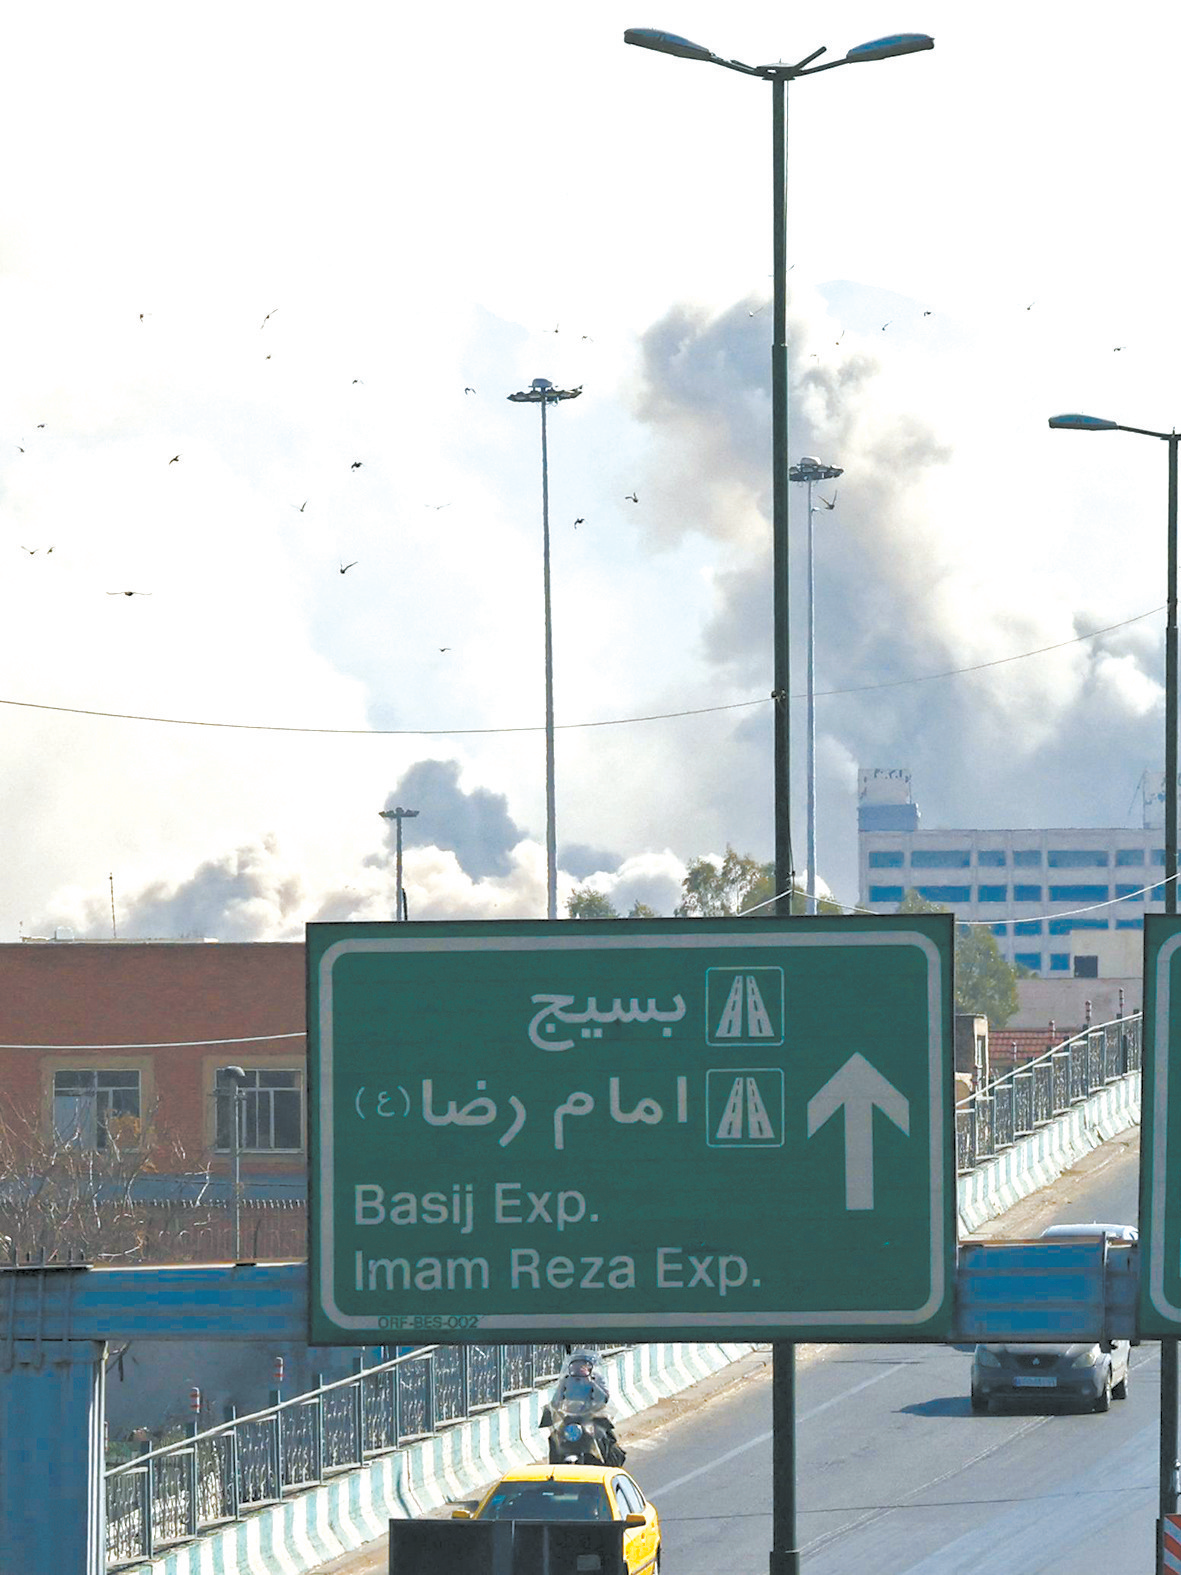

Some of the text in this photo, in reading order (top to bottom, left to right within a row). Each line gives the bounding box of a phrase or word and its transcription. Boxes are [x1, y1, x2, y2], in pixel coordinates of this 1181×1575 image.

[529, 994, 686, 1052] بسیج
[422, 1079, 526, 1147] رضا
[554, 1076, 688, 1150] امام
[355, 1183, 599, 1234] Basij Exp.
[355, 1247, 761, 1296] Imam Reza Exp.
